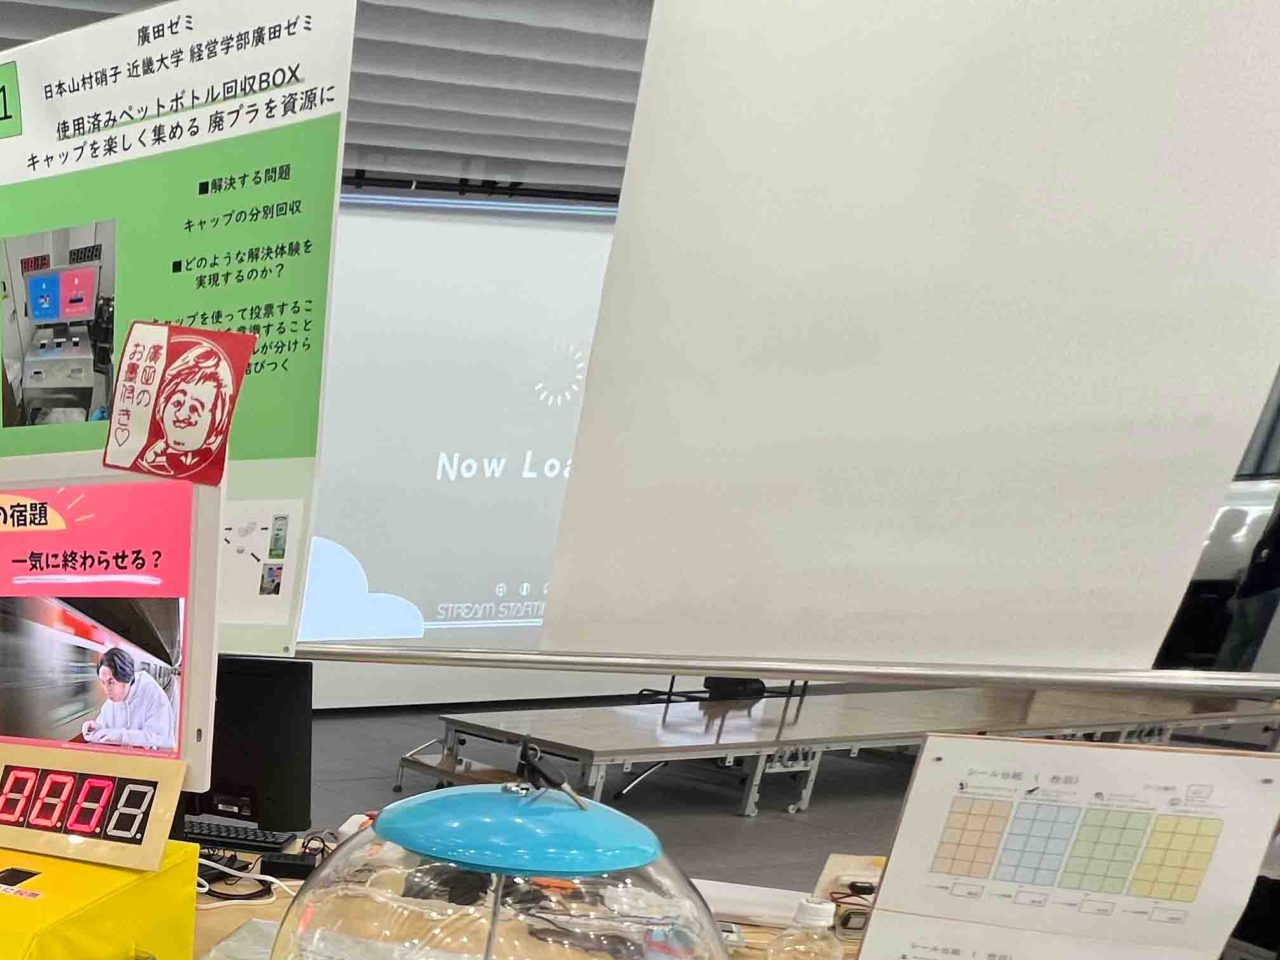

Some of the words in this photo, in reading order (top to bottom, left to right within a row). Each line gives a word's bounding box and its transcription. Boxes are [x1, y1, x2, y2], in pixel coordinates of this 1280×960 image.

[136, 14, 194, 46] 廣田ゼミ
[43, 66, 122, 101] 日本山村硝子
[126, 49, 185, 79] 近畿大学
[189, 15, 313, 64] 経営学部廣田ゼミ
[56, 64, 301, 140] 使用済みペットボトル回収BOX
[26, 117, 200, 171] キャップを楽しく集める
[207, 86, 335, 133] 廃プラを資源に
[183, 199, 302, 232] キャップの分別回収
[153, 299, 314, 327] ップを使って投票するこ
[436, 451, 506, 481] Now
[11, 549, 163, 573] 一気に終わらせる？
